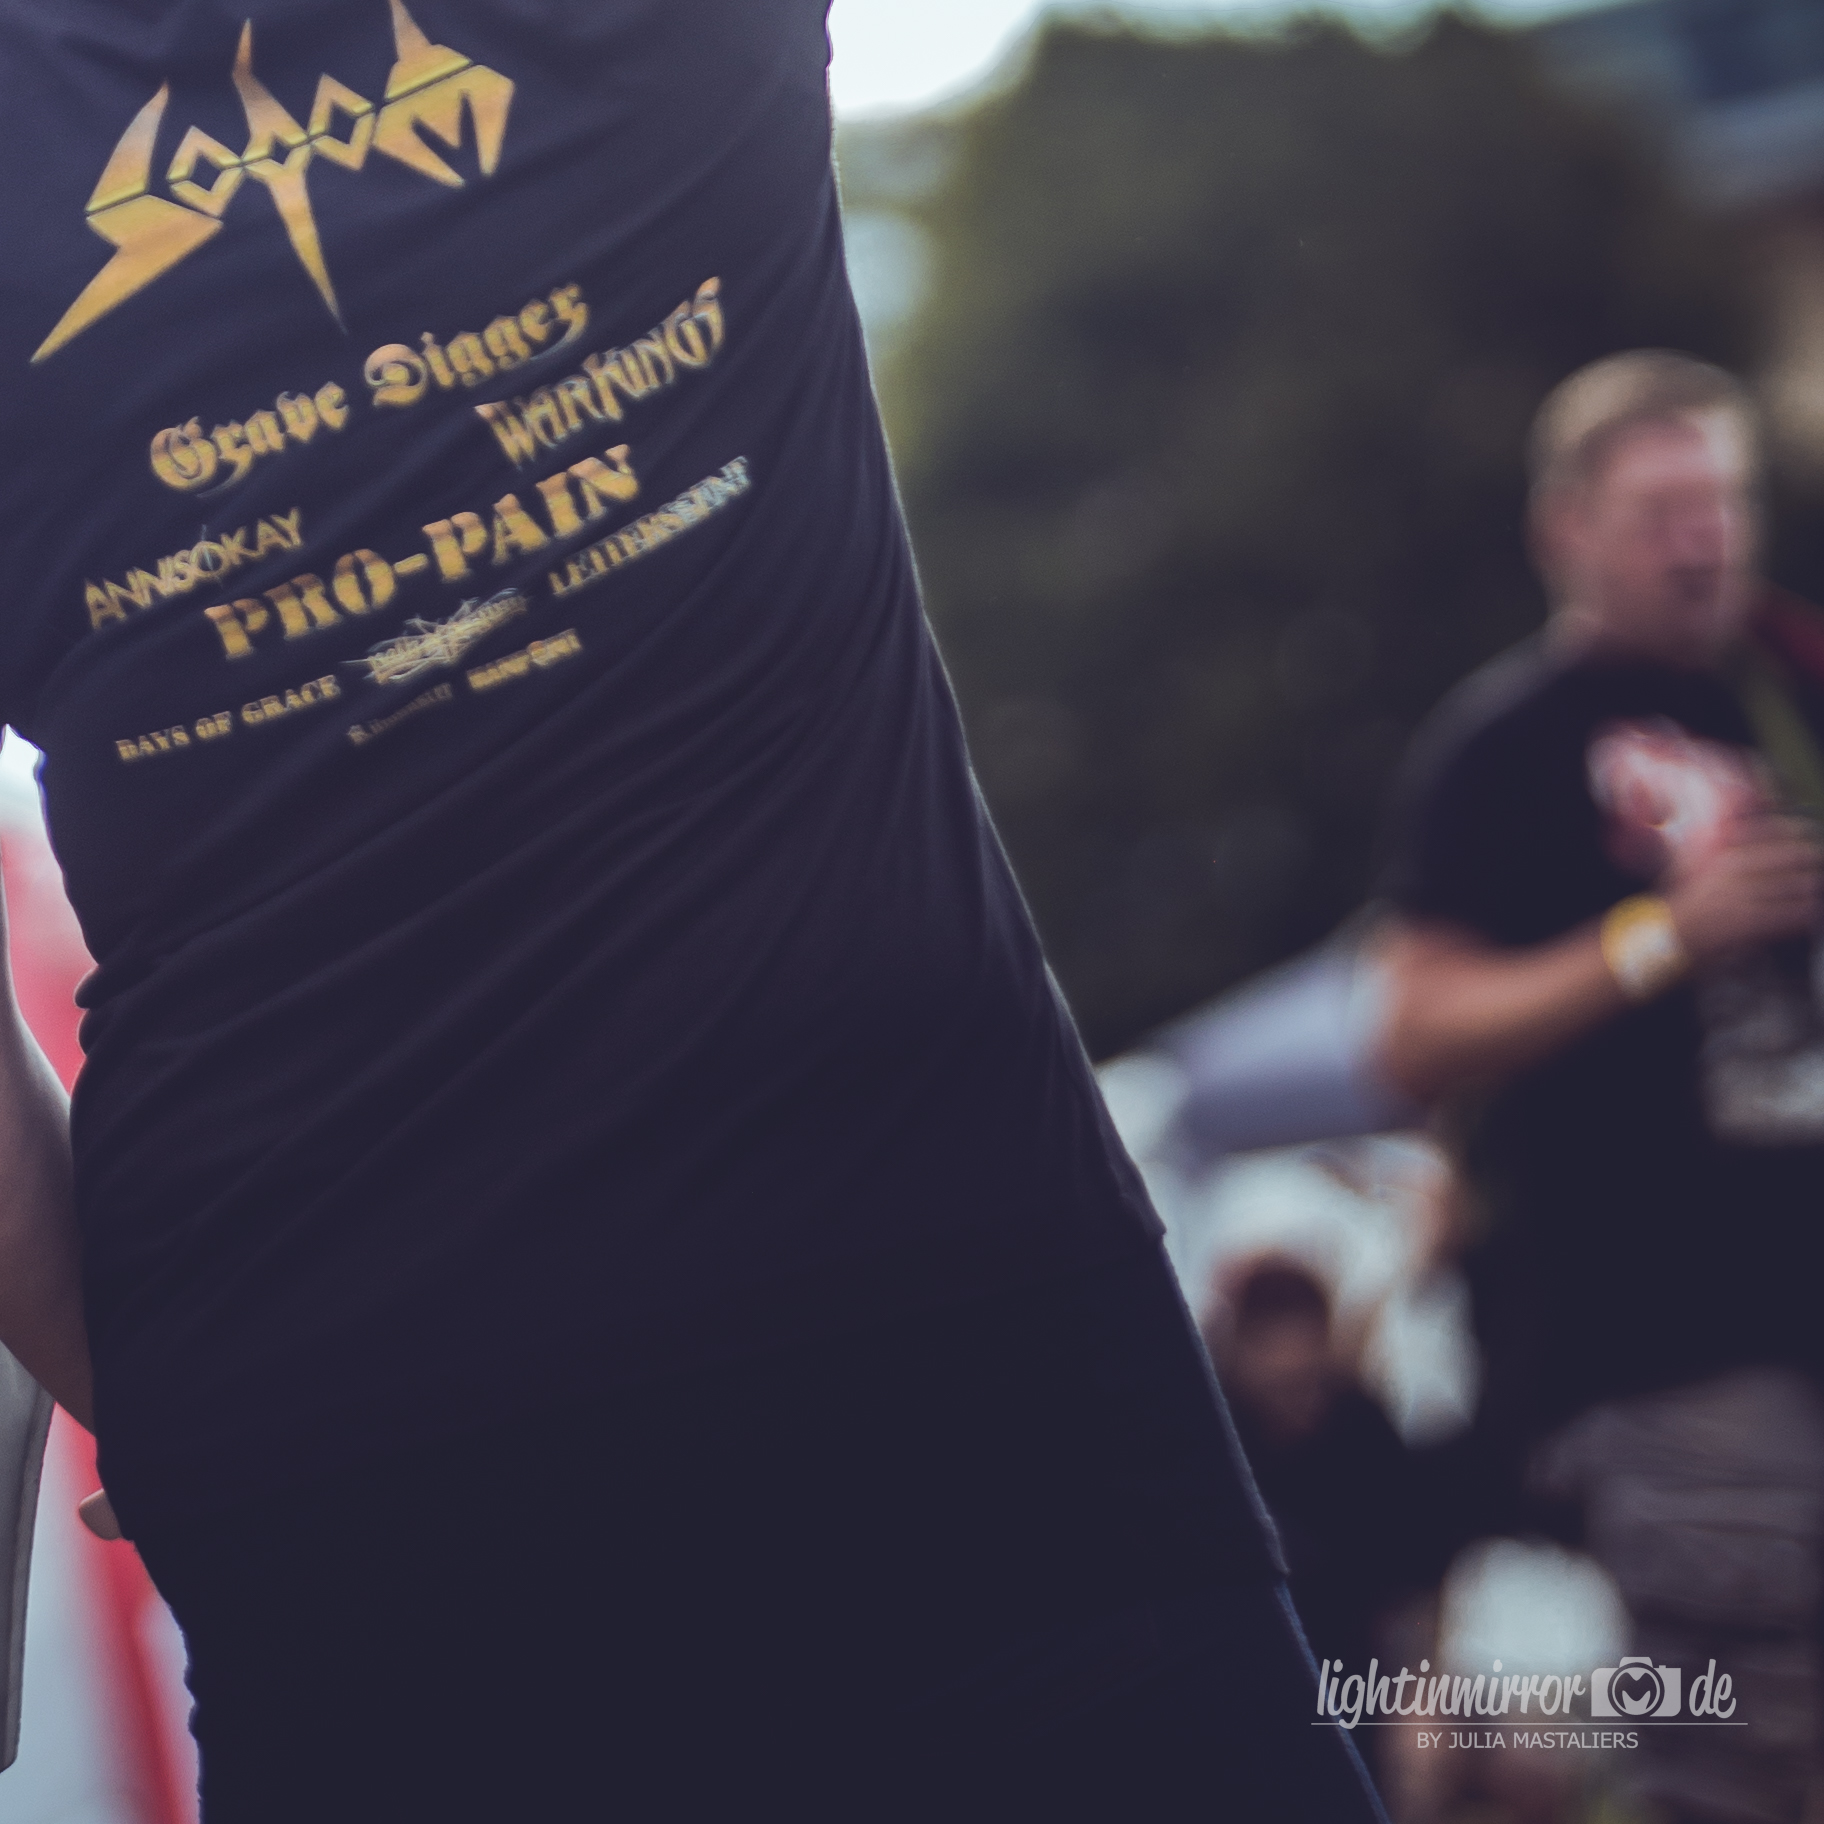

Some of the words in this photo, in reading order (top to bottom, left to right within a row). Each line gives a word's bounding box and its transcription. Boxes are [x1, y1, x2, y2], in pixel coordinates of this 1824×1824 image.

[150, 381, 350, 499] Grave
[364, 283, 588, 407] Digger
[204, 444, 640, 659] PRO-PAIN
[115, 724, 190, 761] DAYS
[195, 710, 232, 740] OF
[240, 674, 341, 726] GRACE
